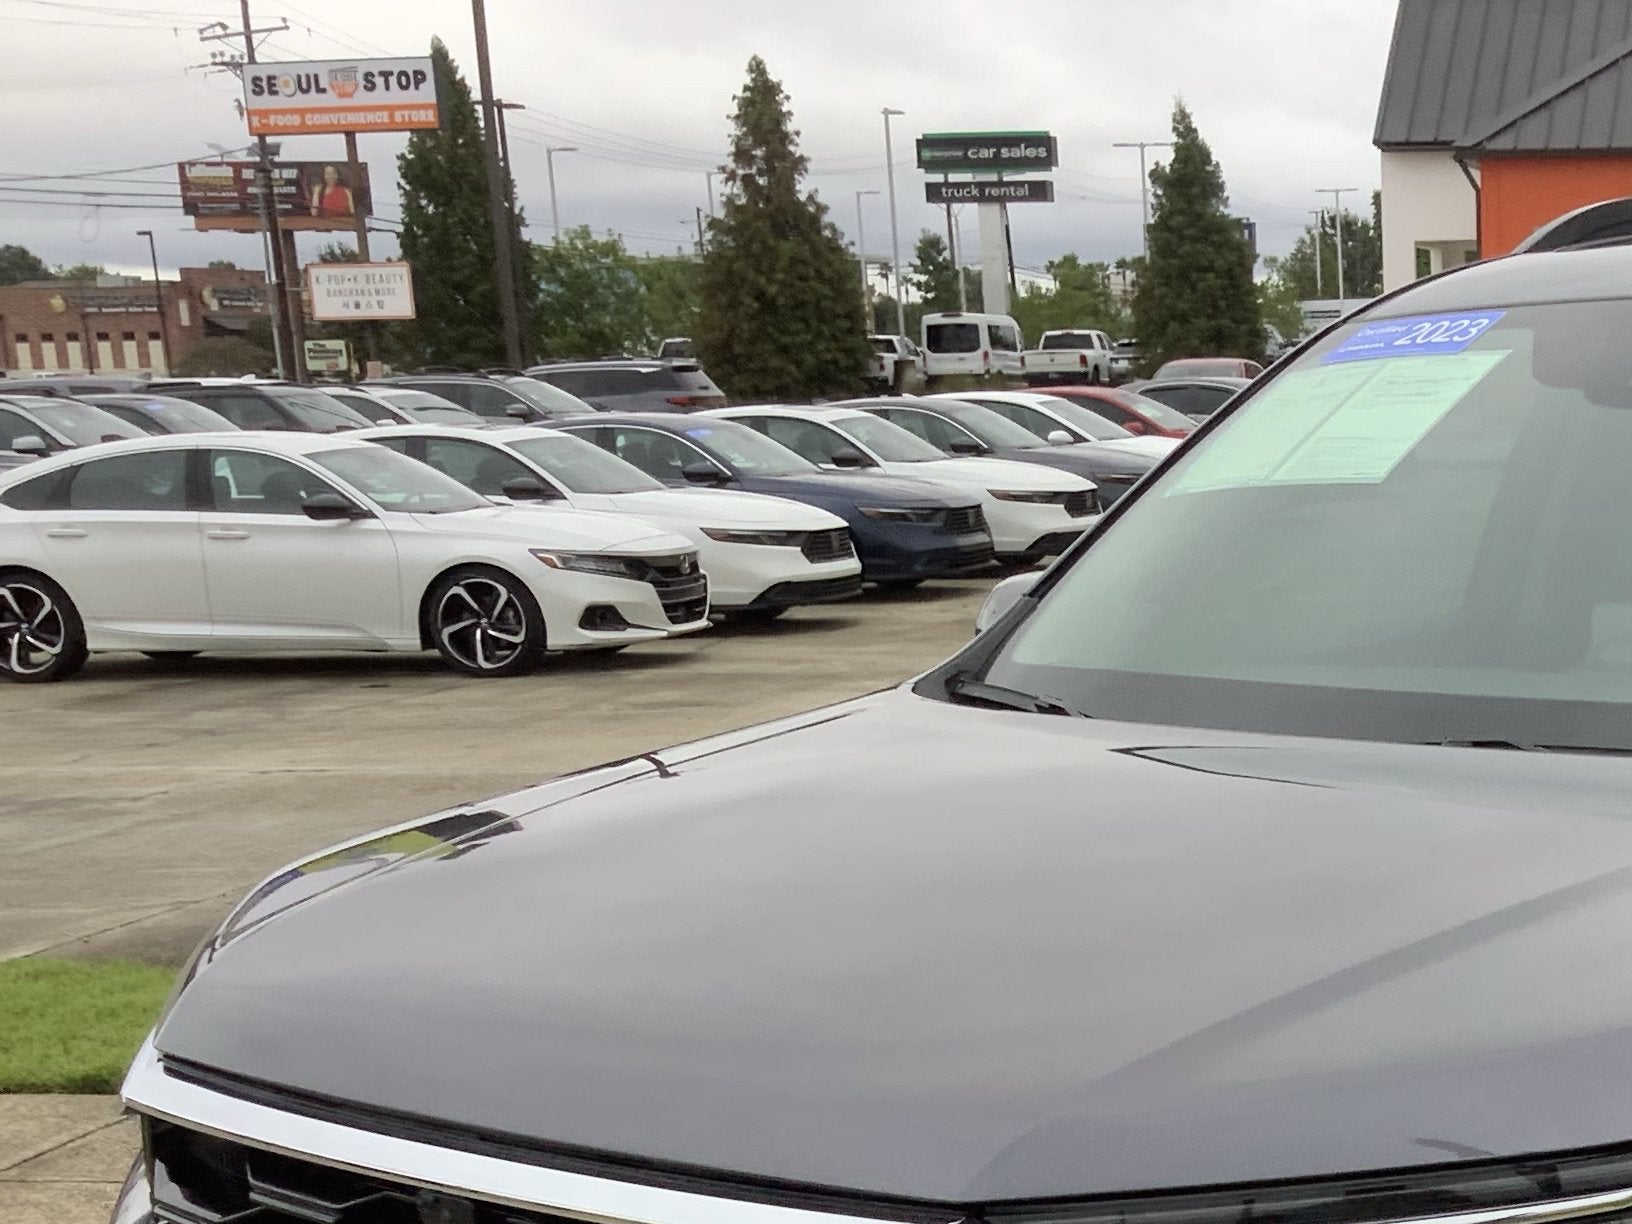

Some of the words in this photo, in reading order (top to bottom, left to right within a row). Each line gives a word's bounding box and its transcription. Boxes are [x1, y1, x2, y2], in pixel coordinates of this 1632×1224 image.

[251, 73, 327, 97] SEOUL
[363, 70, 427, 92] STOP
[305, 111, 389, 126] CONVENIENCE
[967, 147, 996, 159] car
[1001, 143, 1048, 158] sales
[941, 184, 980, 197] truck
[985, 183, 1029, 197] rental
[364, 273, 404, 284] BEAUTY
[1393, 318, 1490, 346] 2023
